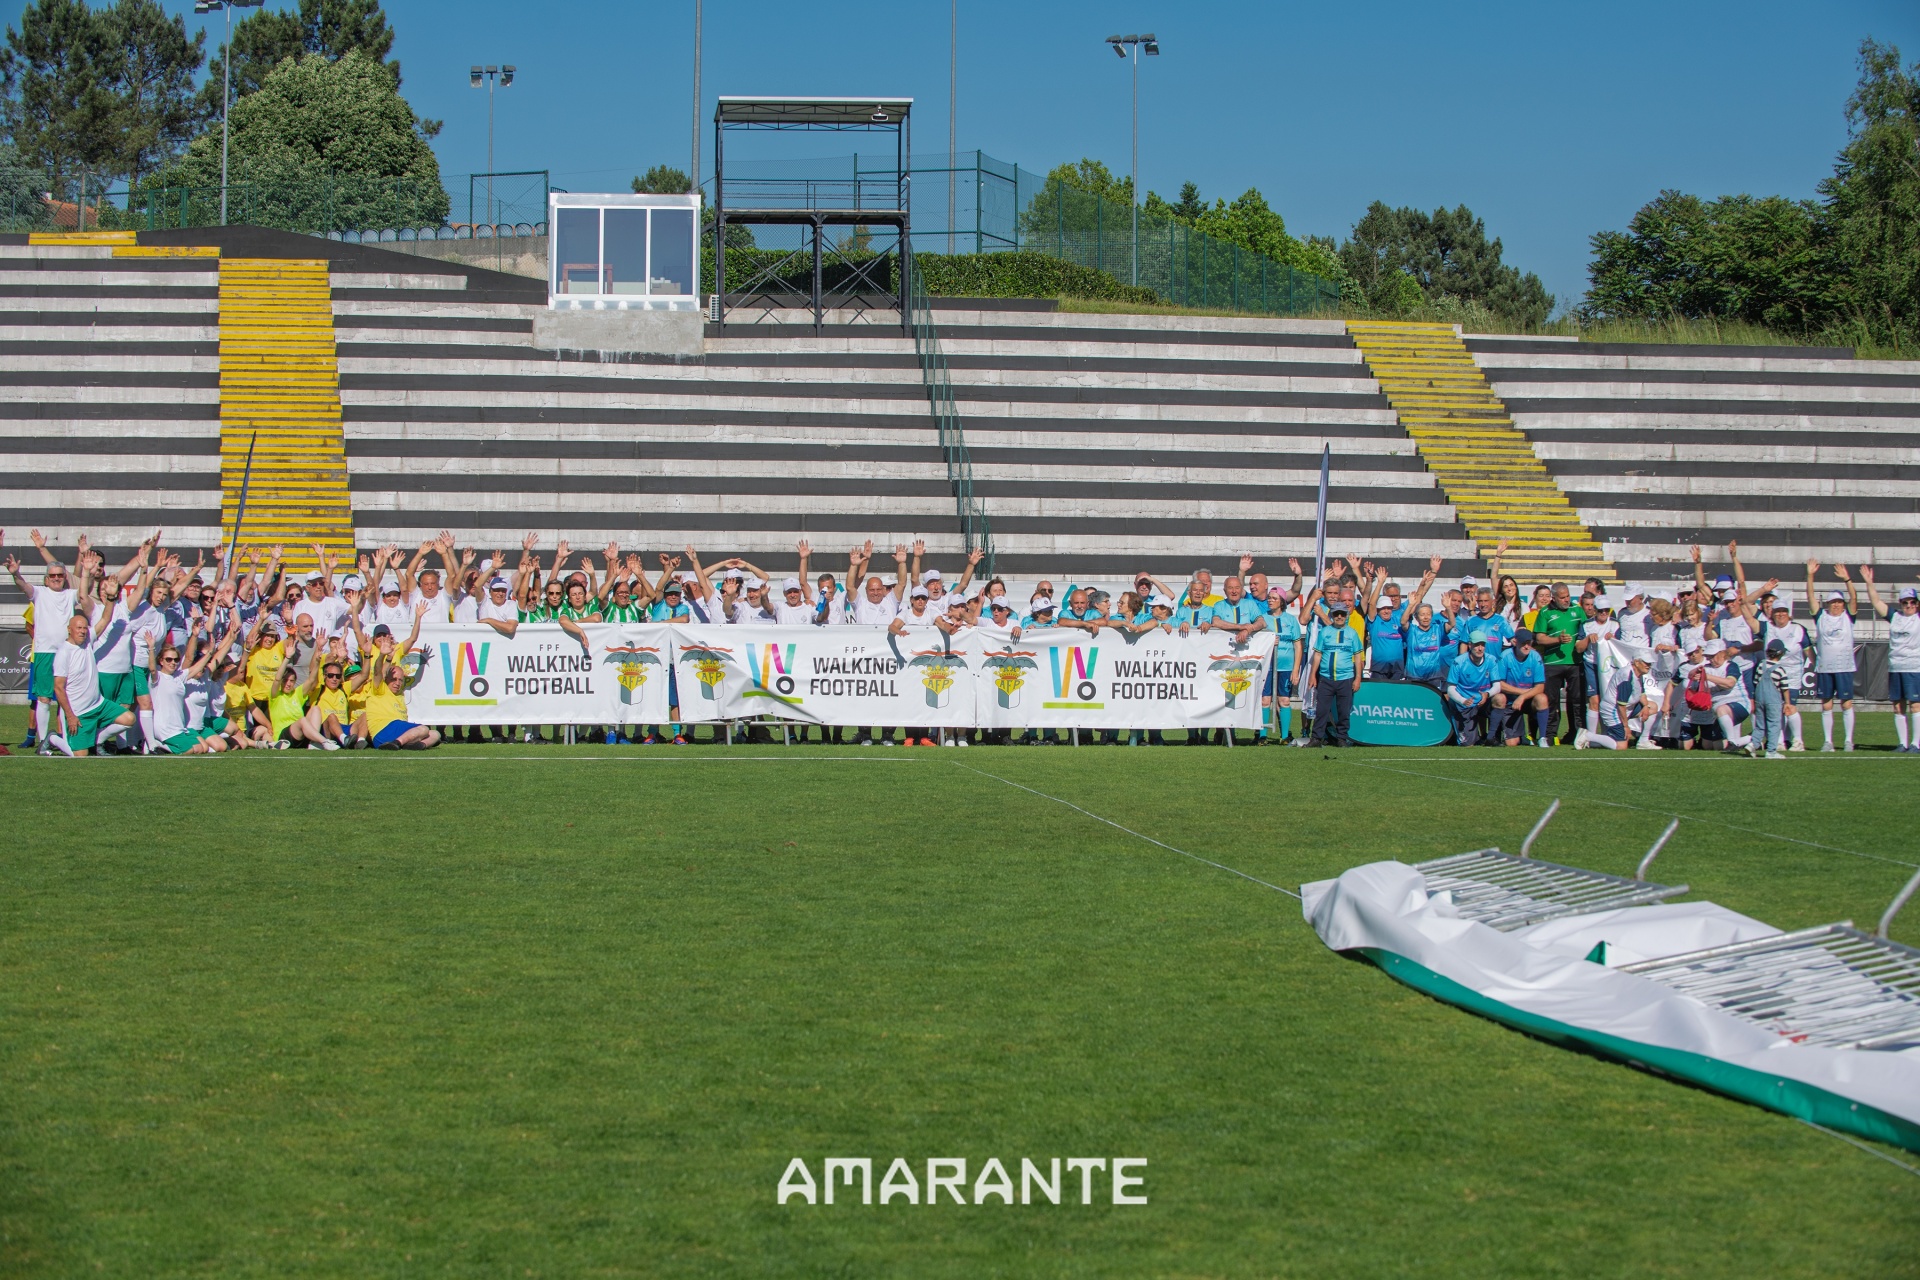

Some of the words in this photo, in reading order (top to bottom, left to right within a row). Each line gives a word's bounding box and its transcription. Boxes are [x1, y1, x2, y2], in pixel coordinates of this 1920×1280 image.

[539, 643, 560, 651] FPF
[845, 646, 865, 654] FPF
[507, 655, 592, 672] WALKING
[813, 657, 897, 675] WALKING
[1115, 660, 1197, 679] WALKING
[621, 676, 643, 689] AFP
[701, 672, 722, 684] AFP
[928, 678, 949, 692] AFP
[505, 677, 594, 695] FOOTBALL
[810, 678, 899, 697] FOOTBALL
[1000, 680, 1021, 694] AFP
[1112, 682, 1198, 701] FOOTBALL
[1227, 681, 1247, 695] AFP
[1350, 705, 1434, 720] AMARANTE
